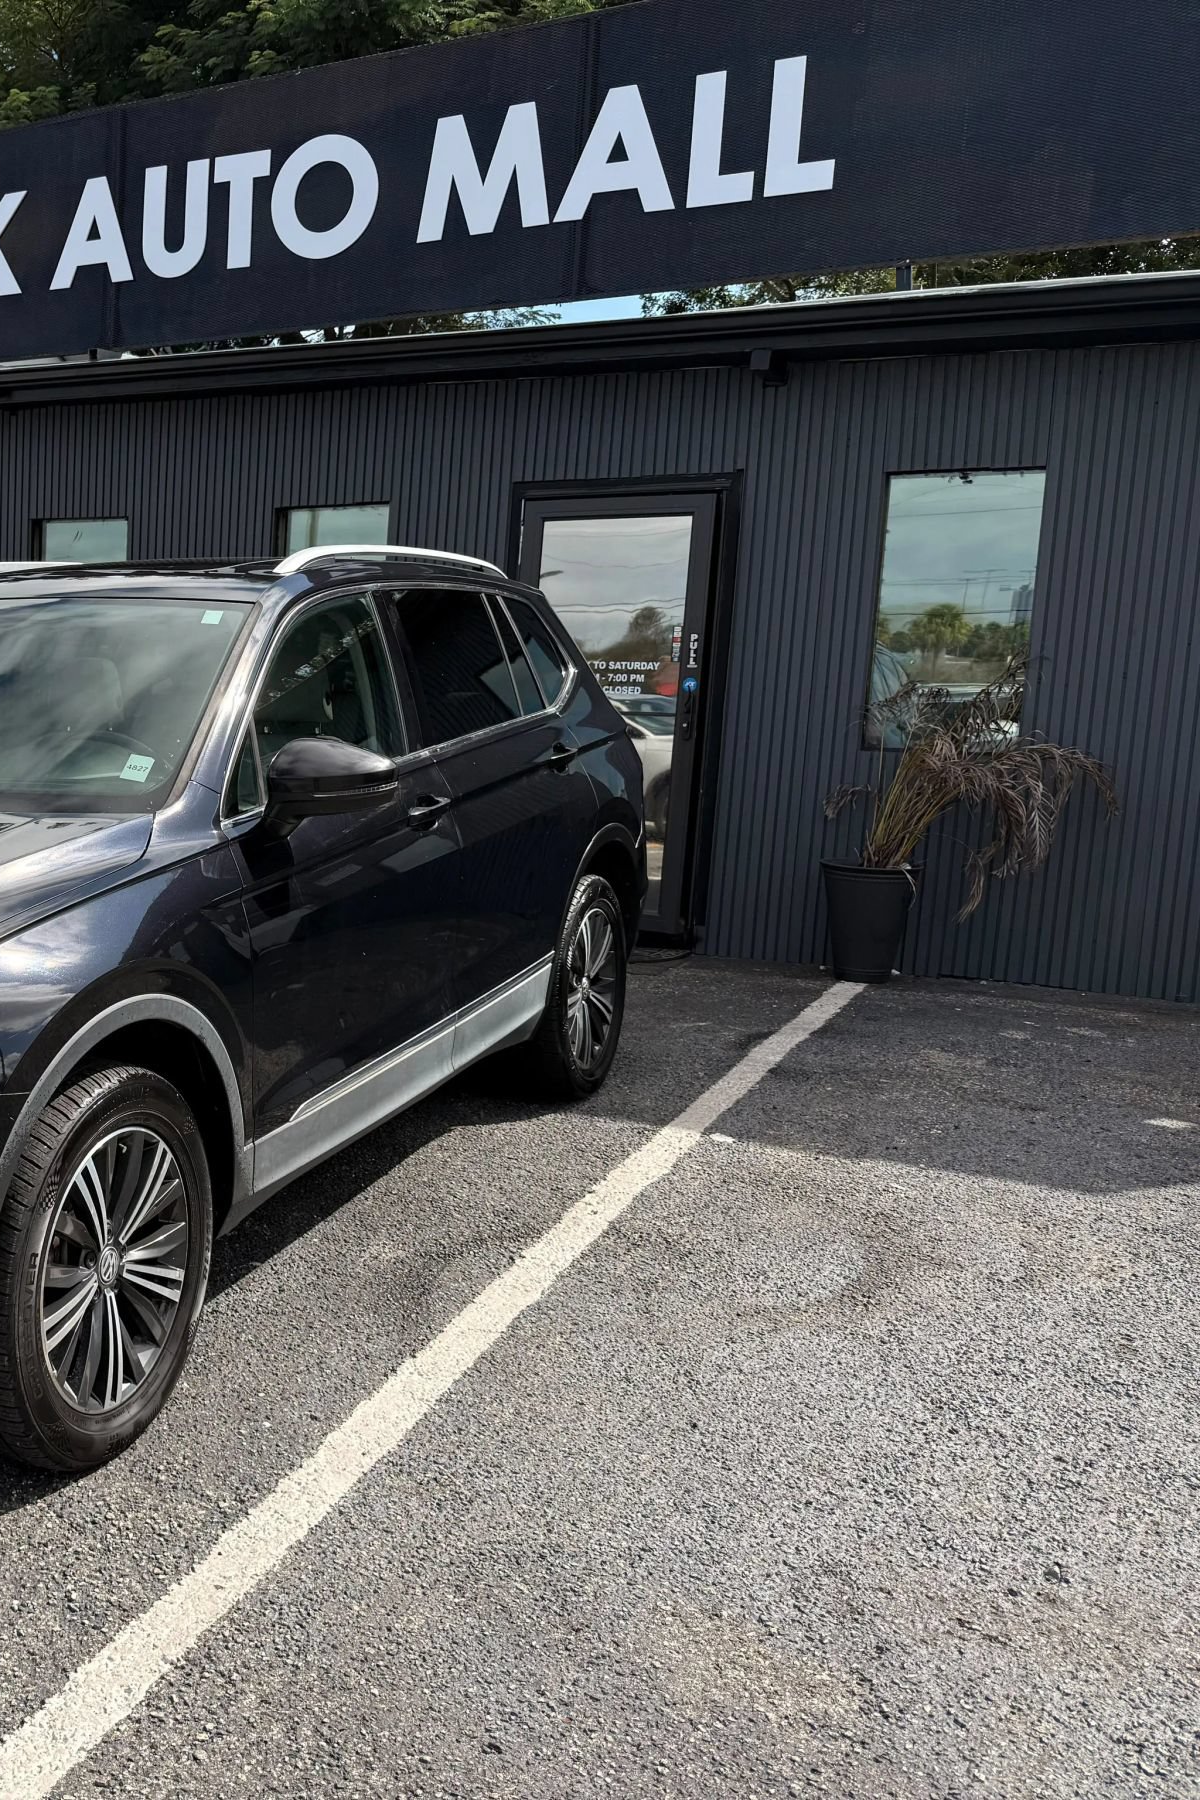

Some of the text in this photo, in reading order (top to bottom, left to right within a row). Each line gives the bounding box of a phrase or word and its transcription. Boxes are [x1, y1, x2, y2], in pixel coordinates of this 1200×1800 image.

[50, 134, 378, 291] AUTO
[417, 56, 836, 244] MALL
[689, 633, 698, 665] PULL
[593, 661, 606, 670] TO
[608, 661, 660, 670] SATURDAY
[607, 673, 628, 682] 7:00
[629, 674, 645, 682] PM
[602, 685, 642, 695] CLOSED
[126, 764, 149, 772] 4827
